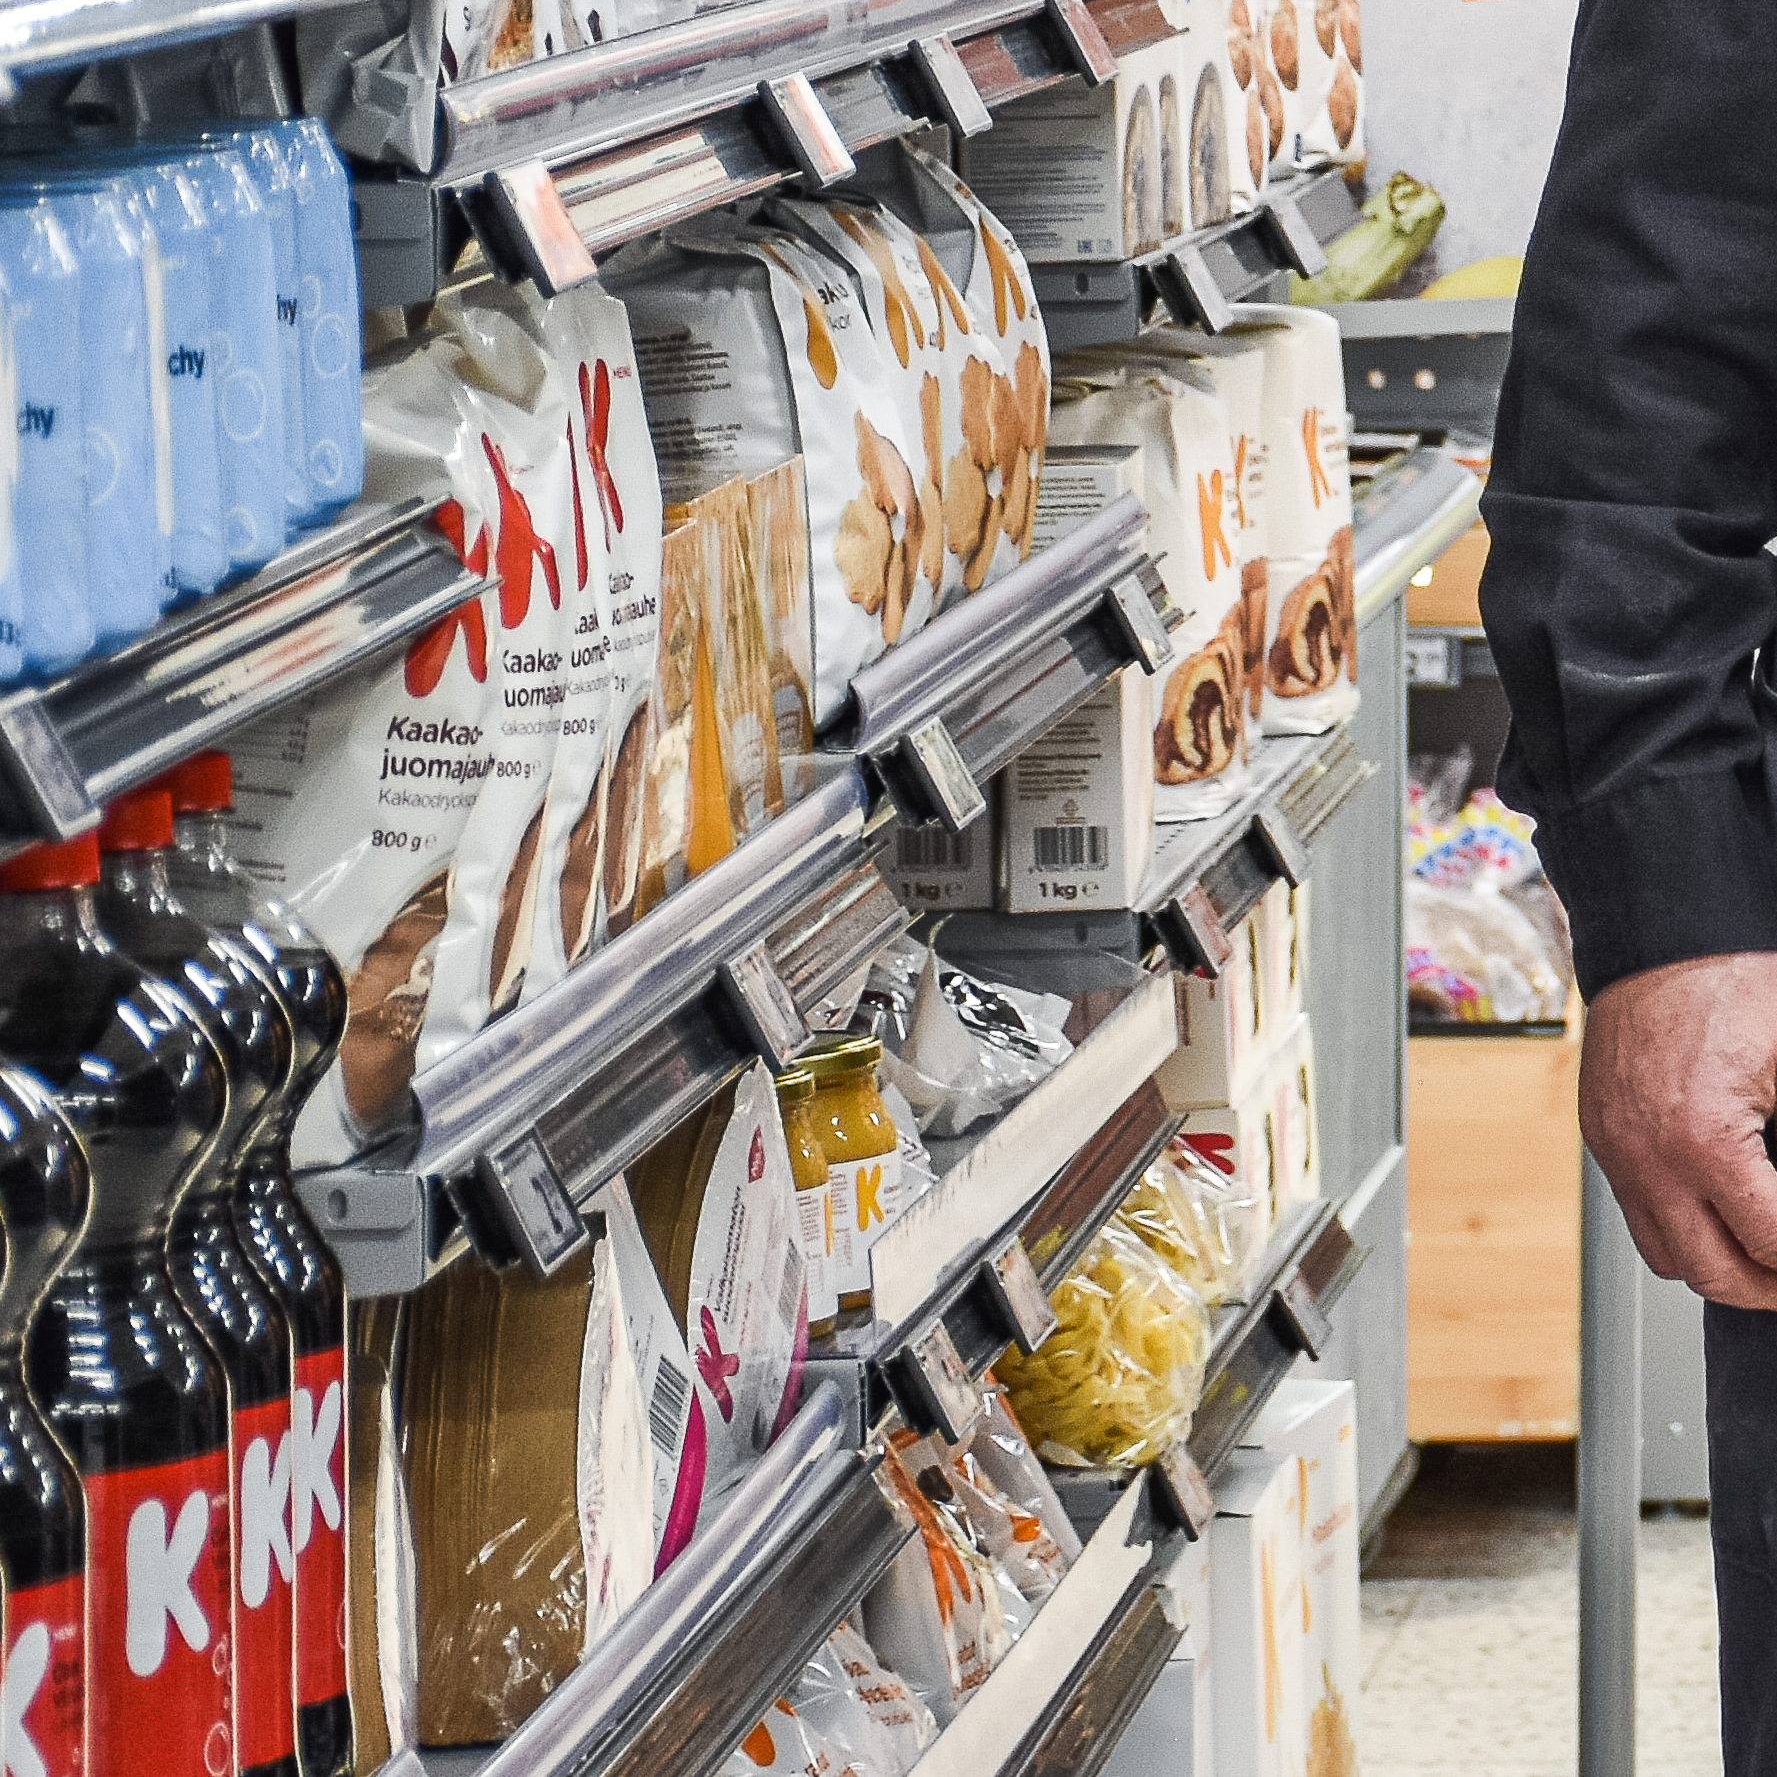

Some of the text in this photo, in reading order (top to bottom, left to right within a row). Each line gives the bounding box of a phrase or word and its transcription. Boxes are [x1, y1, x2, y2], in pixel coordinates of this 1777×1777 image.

[1197, 469, 1232, 582] K
[386, 715, 485, 746] Kaakao-
[562, 718, 588, 736] 800
[496, 760, 523, 778] 800
[371, 828, 423, 852] 800 g
[1038, 881, 1079, 901] 1 kg
[855, 1163, 886, 1232] K
[294, 1380, 343, 1556] K
[126, 1489, 211, 1678] K
